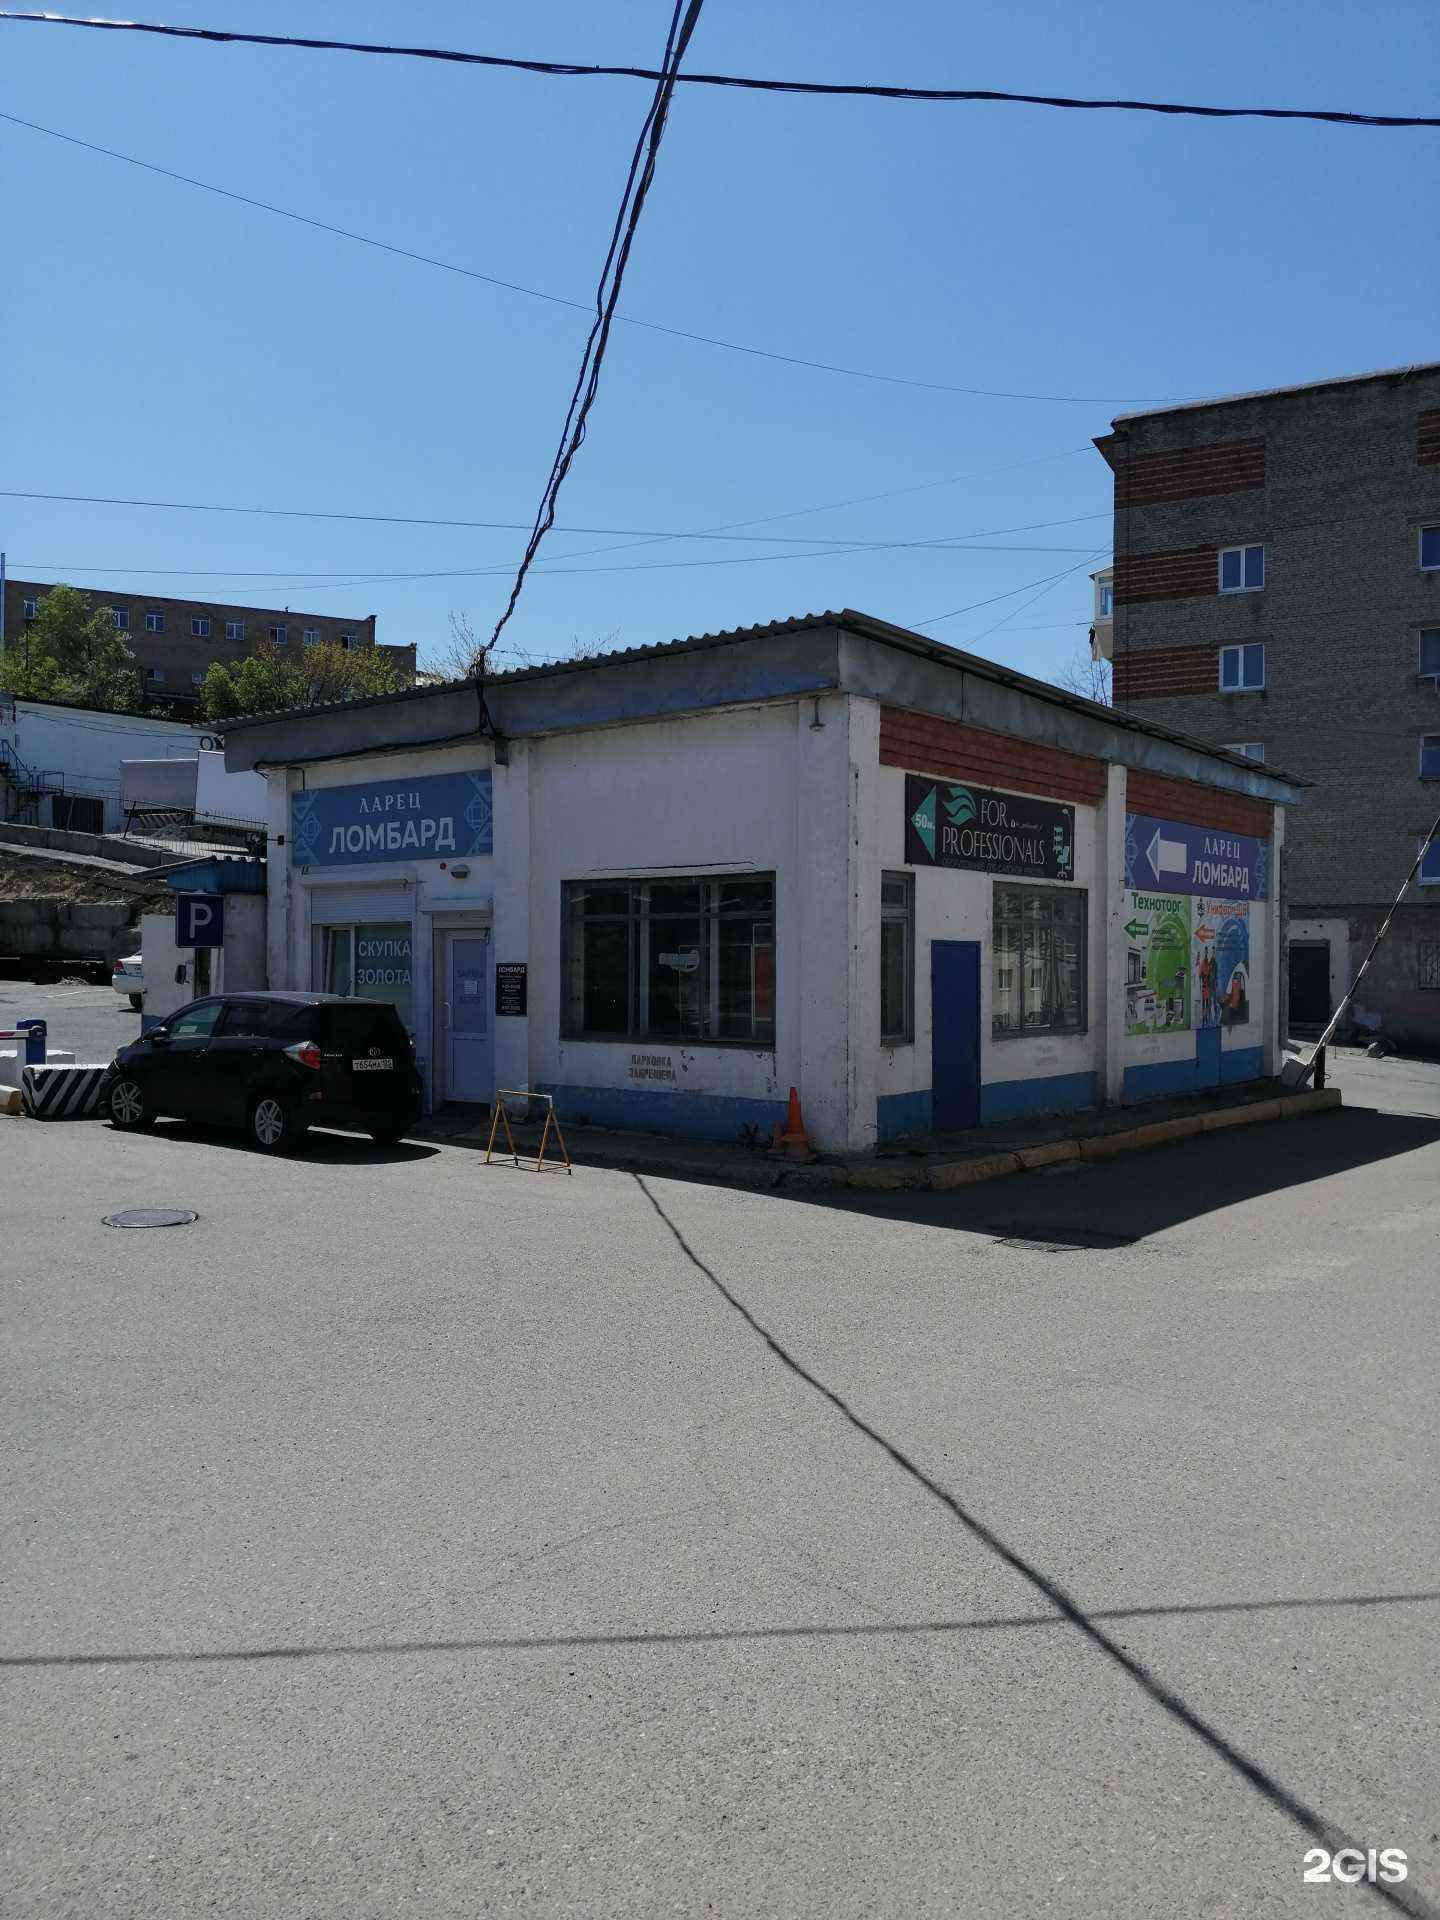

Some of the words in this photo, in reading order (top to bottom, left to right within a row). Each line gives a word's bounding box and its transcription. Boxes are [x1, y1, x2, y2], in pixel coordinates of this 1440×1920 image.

[359, 792, 422, 814] ЛАРЕЦ
[981, 799, 1008, 828] FOR
[329, 817, 456, 854] ЛОМБАРД
[942, 826, 1046, 865] PROFESSIONALS
[1203, 837, 1241, 859] ЛАРЕЦ
[1192, 860, 1249, 894] ЛОМБАРД
[1131, 892, 1183, 913] Техноторг
[189, 902, 213, 939] P
[358, 941, 412, 957] СКУПКА
[357, 968, 412, 985] ЗОЛОТА
